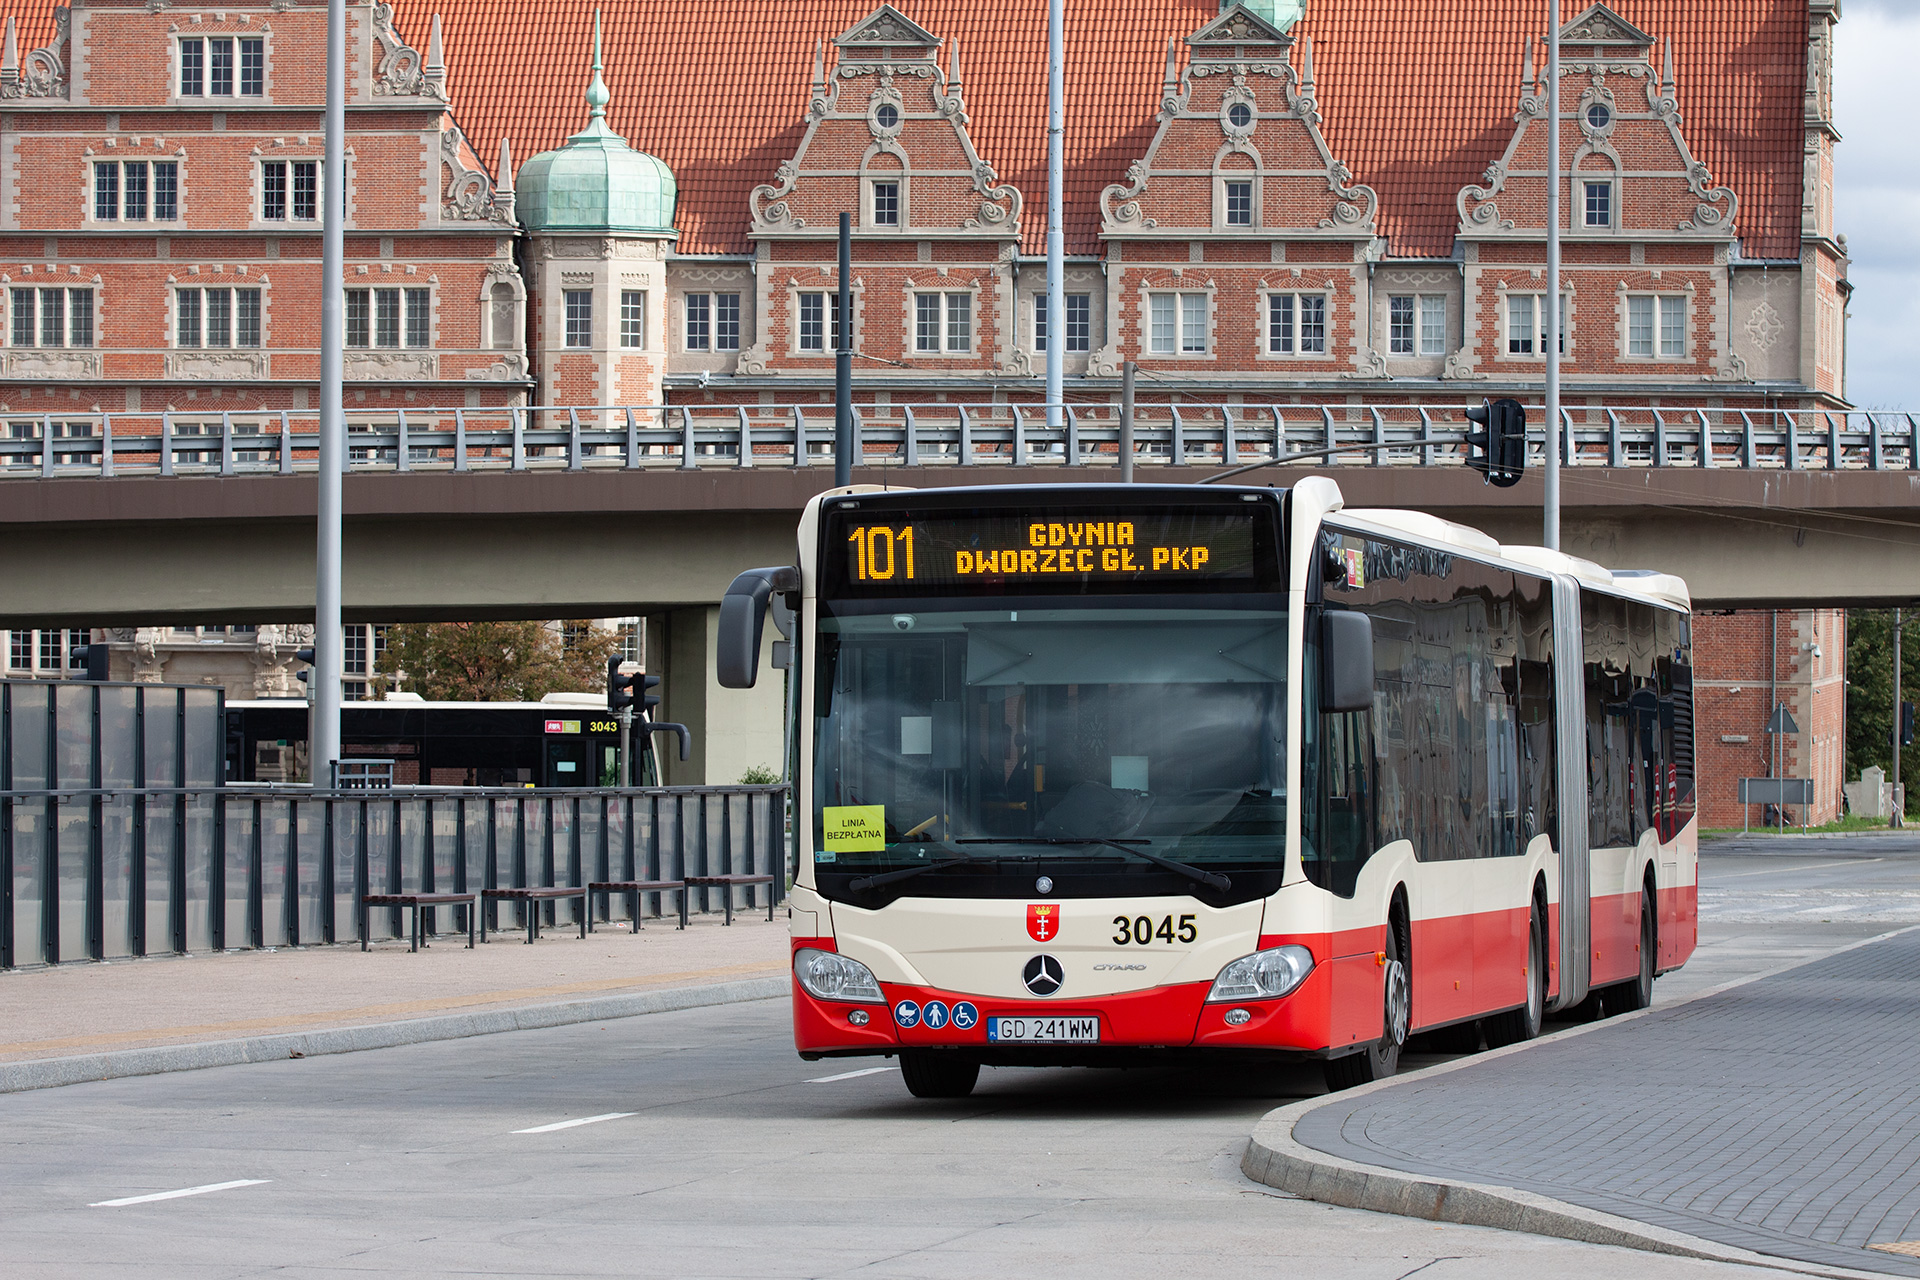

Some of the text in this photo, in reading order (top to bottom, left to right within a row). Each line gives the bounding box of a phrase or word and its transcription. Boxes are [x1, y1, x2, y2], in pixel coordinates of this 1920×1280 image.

[1029, 522, 1134, 546] GDYNIA
[848, 526, 914, 579] 101
[956, 546, 1209, 574] DWORZEC GŁ. PKP
[590, 721, 617, 732] 3043
[842, 818, 866, 827] LINIA
[826, 830, 882, 840] BEZPŁATNA
[1112, 914, 1198, 945] 3045
[1001, 1019, 1093, 1038] GD 241WM
